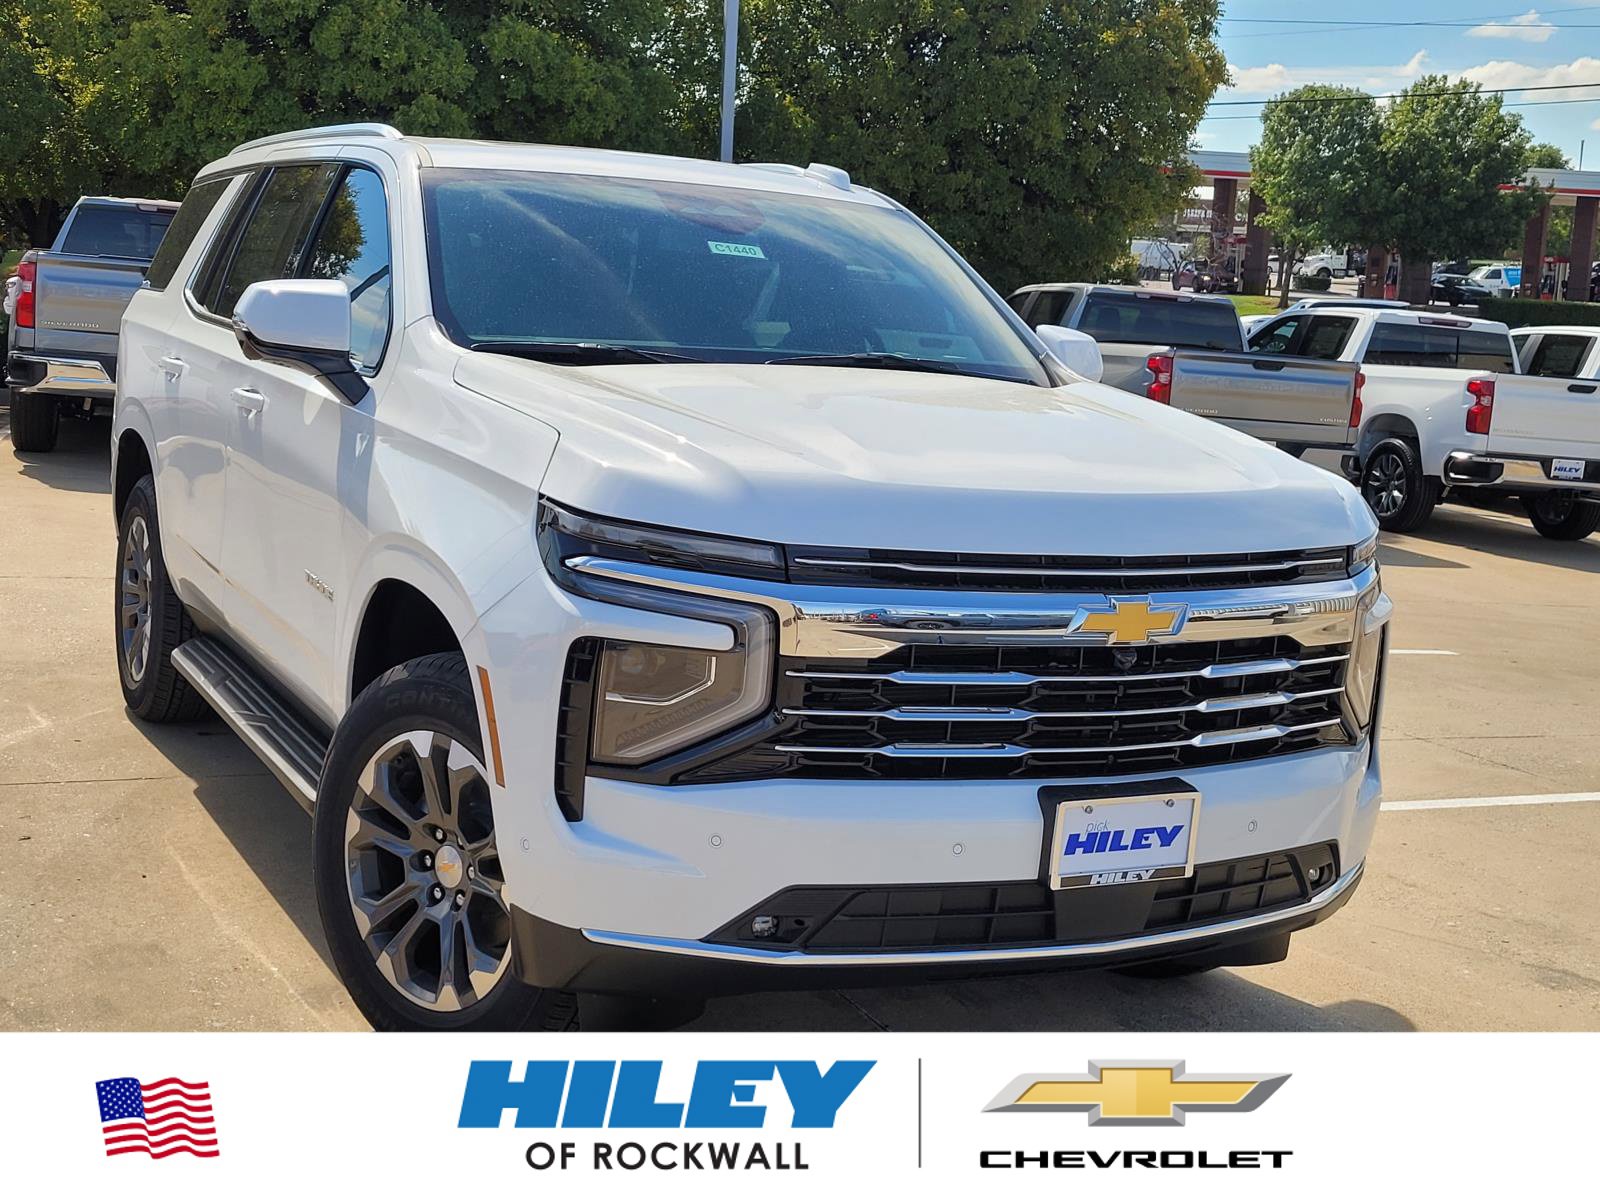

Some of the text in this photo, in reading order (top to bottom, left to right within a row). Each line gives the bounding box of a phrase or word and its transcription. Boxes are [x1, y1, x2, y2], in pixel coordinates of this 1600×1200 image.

[715, 244, 756, 255] C1440
[1064, 825, 1184, 856] HILEY
[1090, 869, 1156, 885] HILEY
